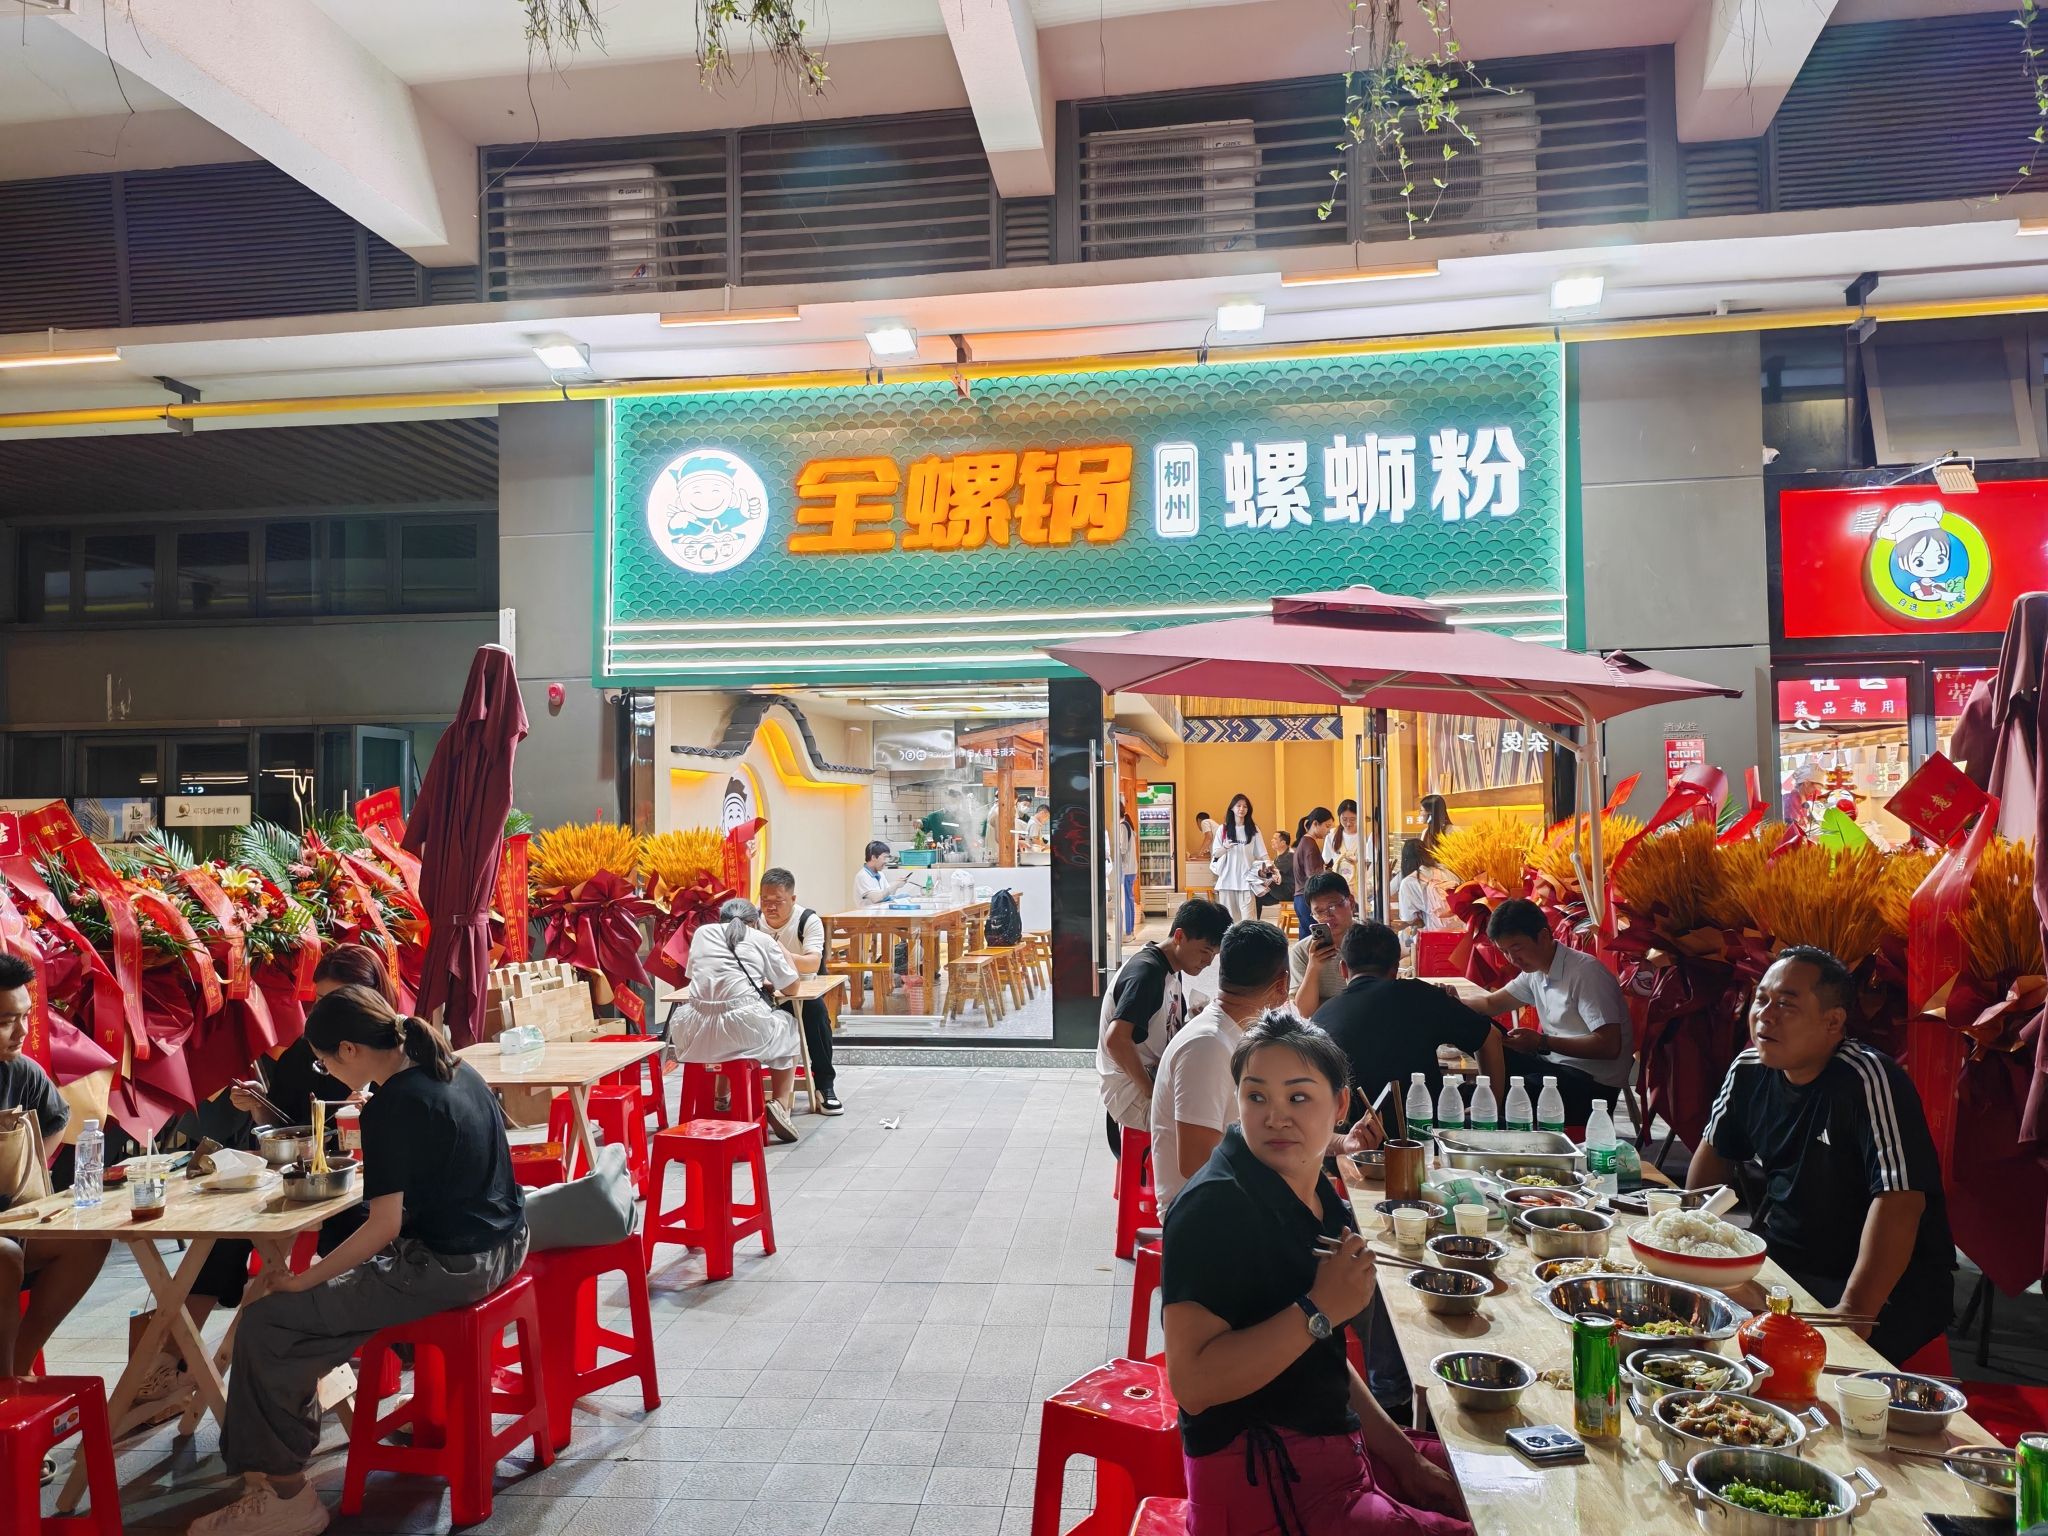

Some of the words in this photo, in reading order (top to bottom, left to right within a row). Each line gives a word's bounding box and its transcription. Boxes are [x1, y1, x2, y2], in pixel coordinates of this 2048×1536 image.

[789, 445, 1133, 553] 全螺锅
[1163, 460, 1191, 521] 柳州
[1223, 427, 1526, 529] 螺蛳粉
